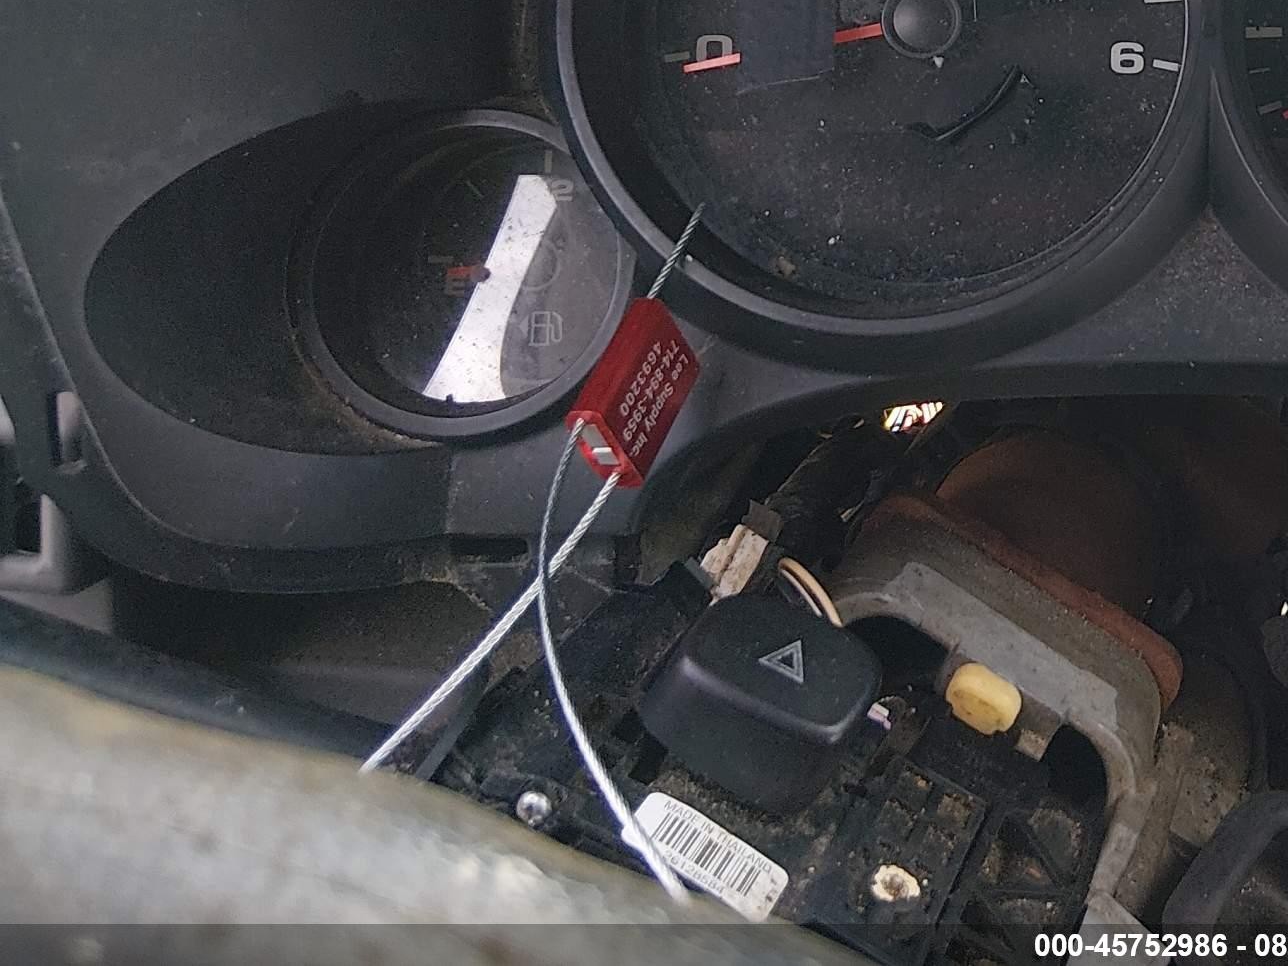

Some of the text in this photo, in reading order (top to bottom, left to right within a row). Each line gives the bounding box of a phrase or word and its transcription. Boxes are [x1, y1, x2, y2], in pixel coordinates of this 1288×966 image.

[696, 35, 734, 64] 0
[1109, 42, 1144, 74] 6
[620, 341, 661, 416] 4693200
[623, 339, 680, 442] 714-894-3959
[629, 353, 689, 457] Lee Supply Inc.
[663, 800, 773, 874] MADE IN THAILAND
